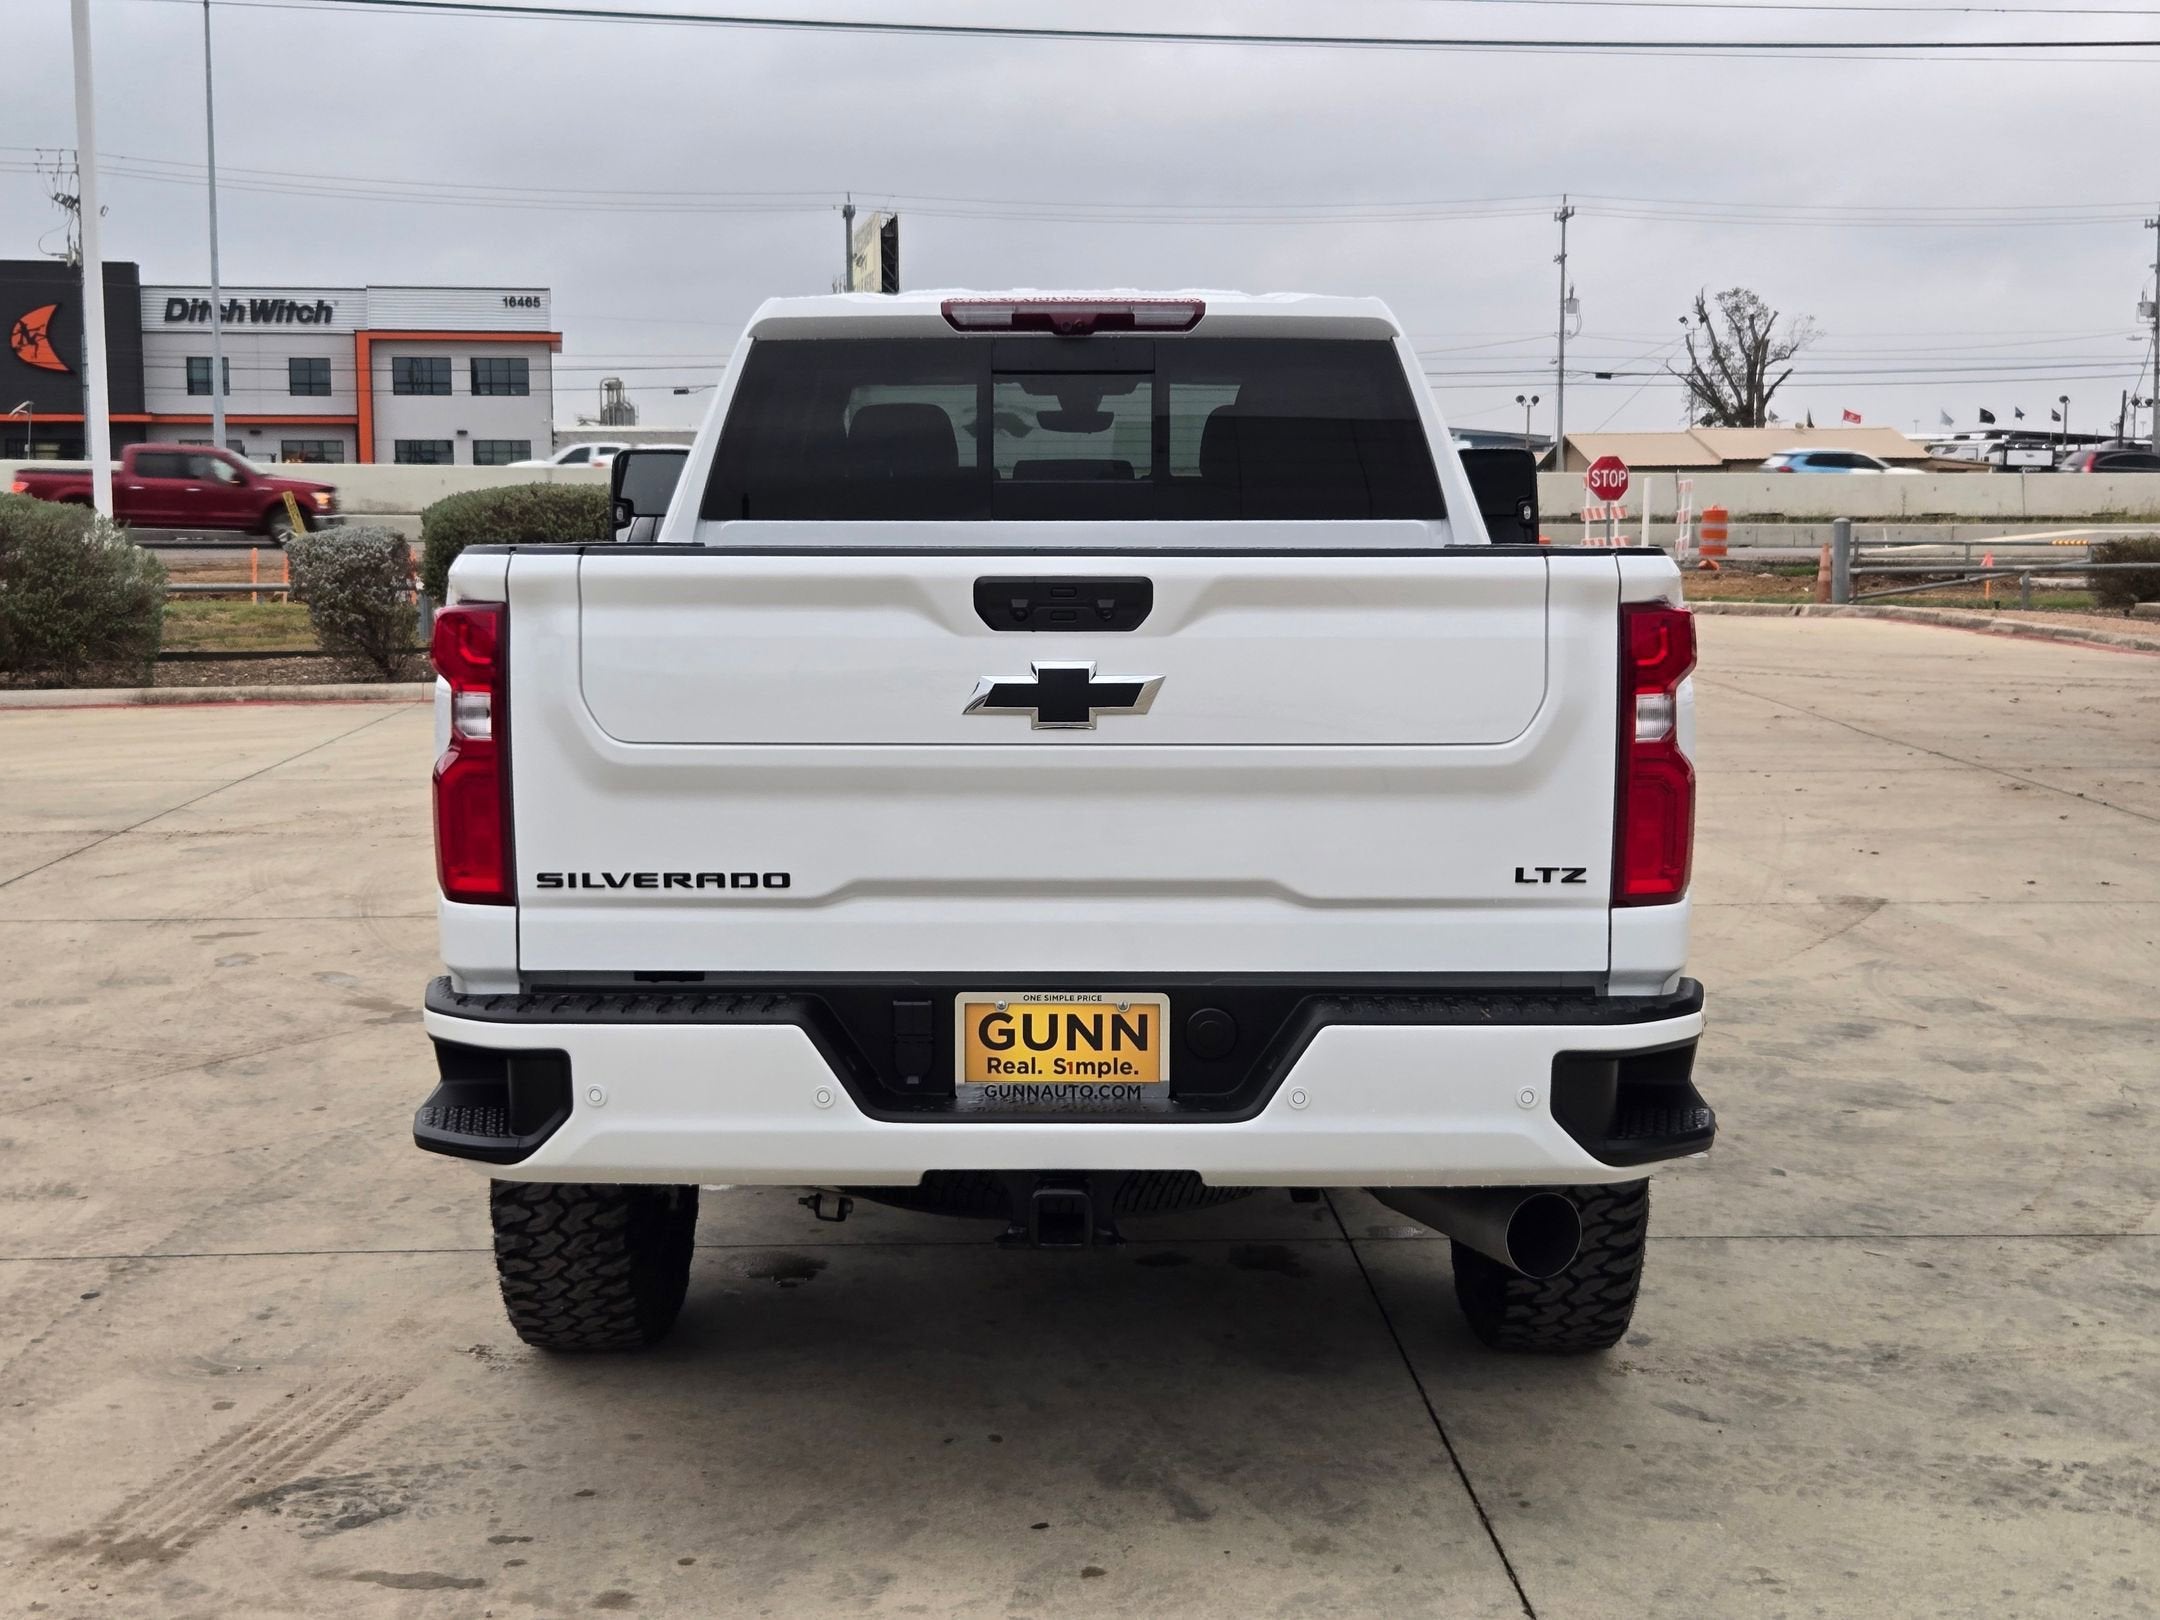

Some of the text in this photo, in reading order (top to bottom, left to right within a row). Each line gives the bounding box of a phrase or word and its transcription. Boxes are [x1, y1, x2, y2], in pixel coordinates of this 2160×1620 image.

[502, 295, 541, 308] 16465
[249, 298, 333, 324] Witch
[1591, 469, 1627, 488] STOP
[536, 872, 791, 889] SILVERADO
[1514, 867, 1587, 883] LTZ
[1023, 994, 1103, 1002] ONE SIMPLE PRICE
[978, 1011, 1149, 1052] GUNN
[987, 1057, 1043, 1075] Real.
[984, 1084, 1142, 1100] GUNNAUTO.COM
